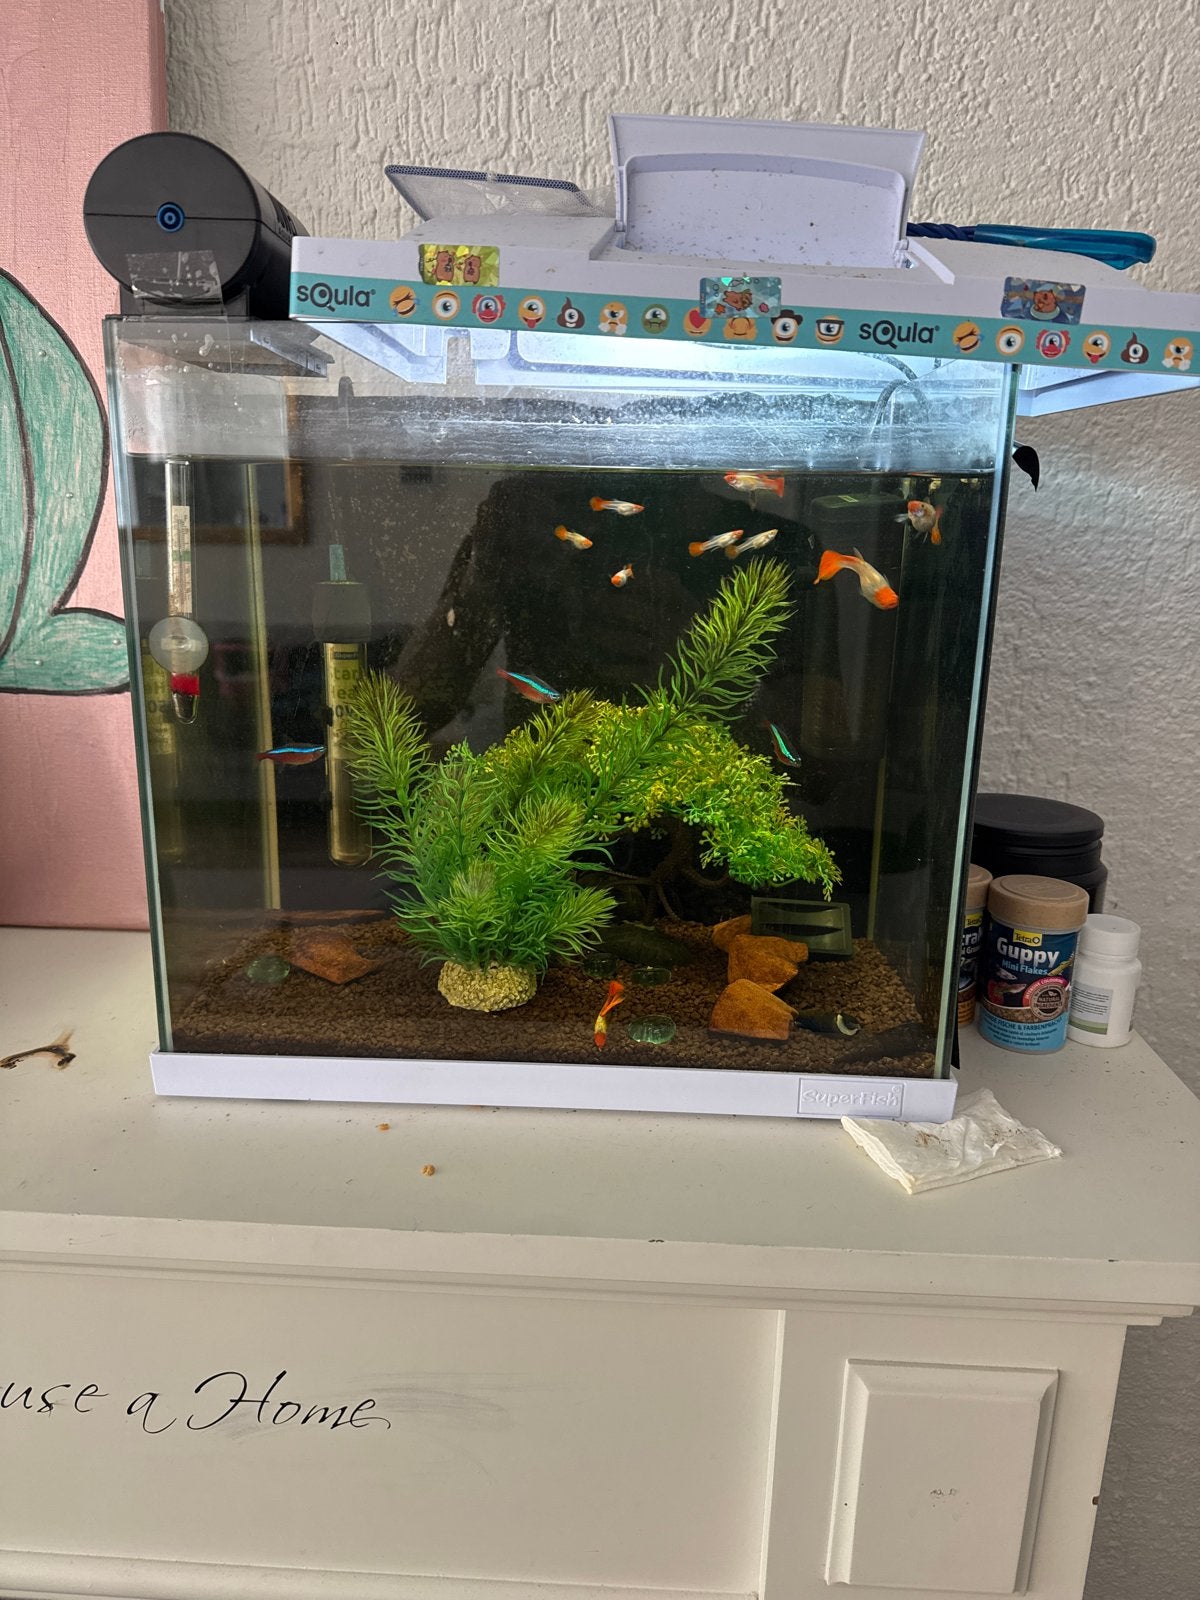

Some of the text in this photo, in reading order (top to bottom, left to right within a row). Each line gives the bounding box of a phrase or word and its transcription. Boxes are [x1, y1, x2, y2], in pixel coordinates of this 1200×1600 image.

[996, 936, 1060, 968] Guppy
[1001, 959, 1048, 976] Mini Flakes
[801, 1088, 898, 1107] SuperFish
[0, 1370, 392, 1434] use a Home
